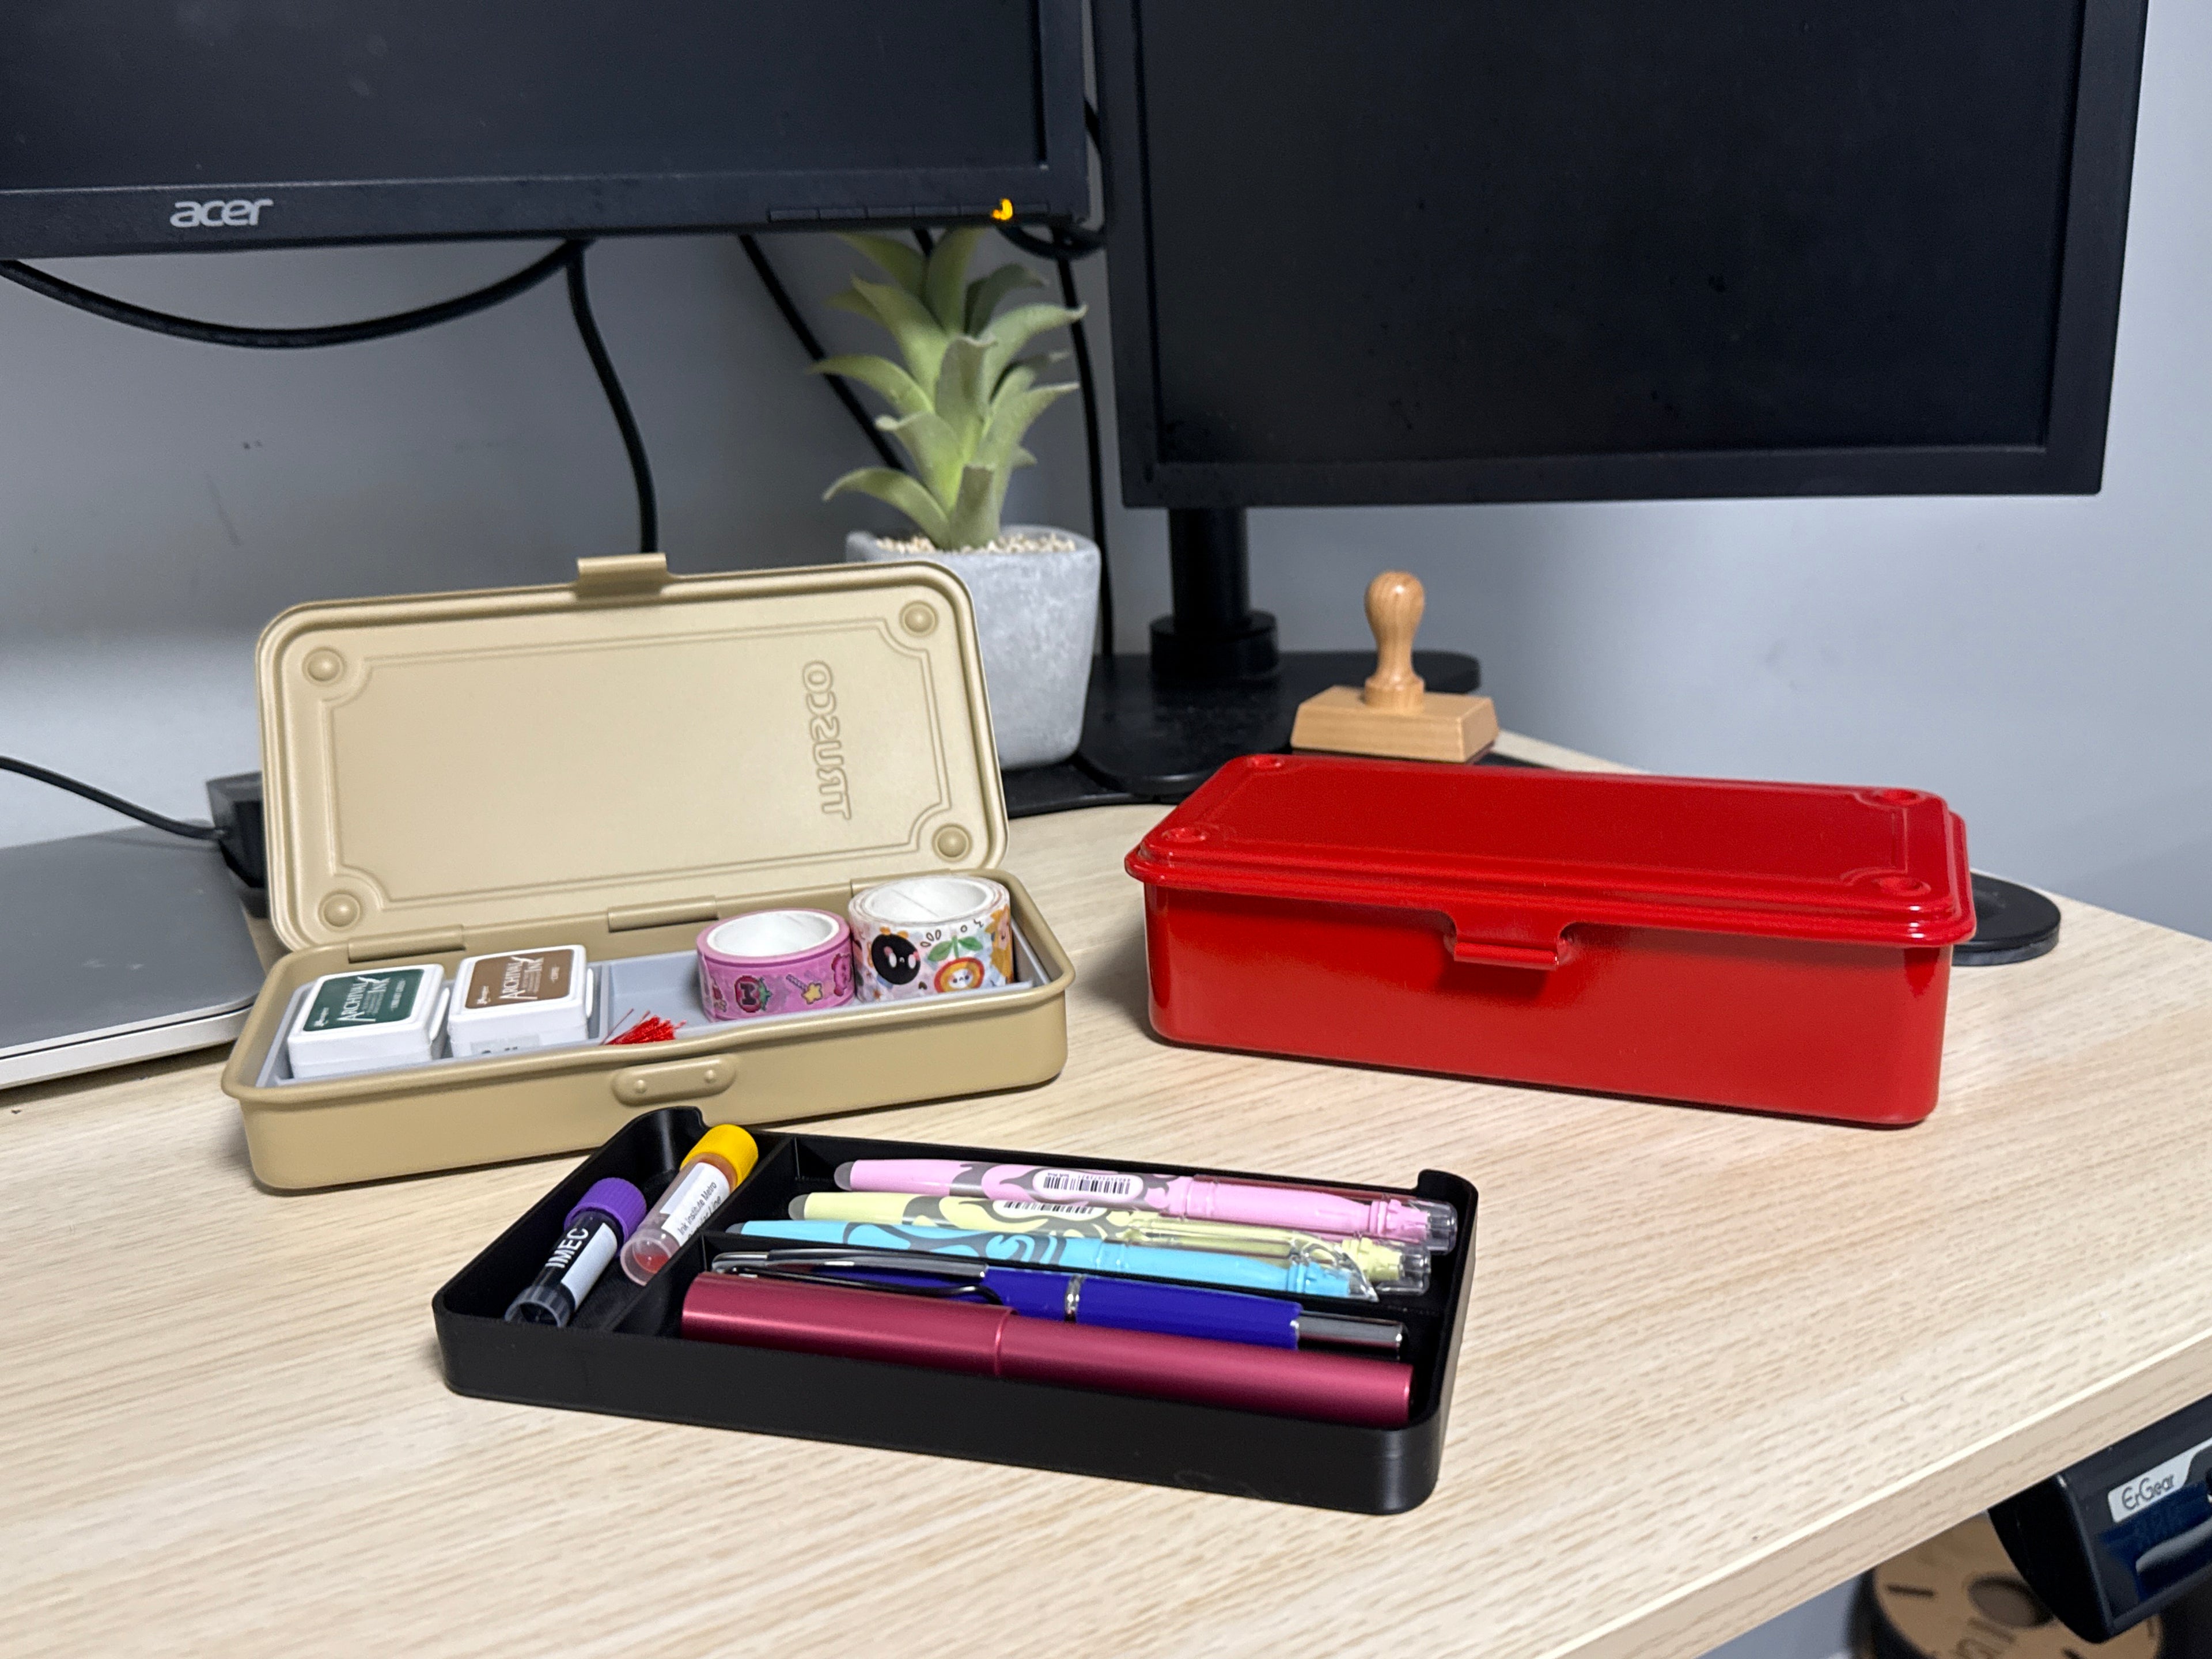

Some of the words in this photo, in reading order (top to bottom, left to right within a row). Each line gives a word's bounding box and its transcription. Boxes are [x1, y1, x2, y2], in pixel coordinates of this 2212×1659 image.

[169, 198, 274, 228] acer
[499, 956, 538, 999] ARCHIVAL
[337, 976, 376, 1022] ARCHIVAL
[677, 1222, 689, 1236] Ink
[700, 1181, 717, 1201] Metro
[544, 1228, 589, 1268] IMEC
[2121, 1474, 2175, 1510] ErGear
